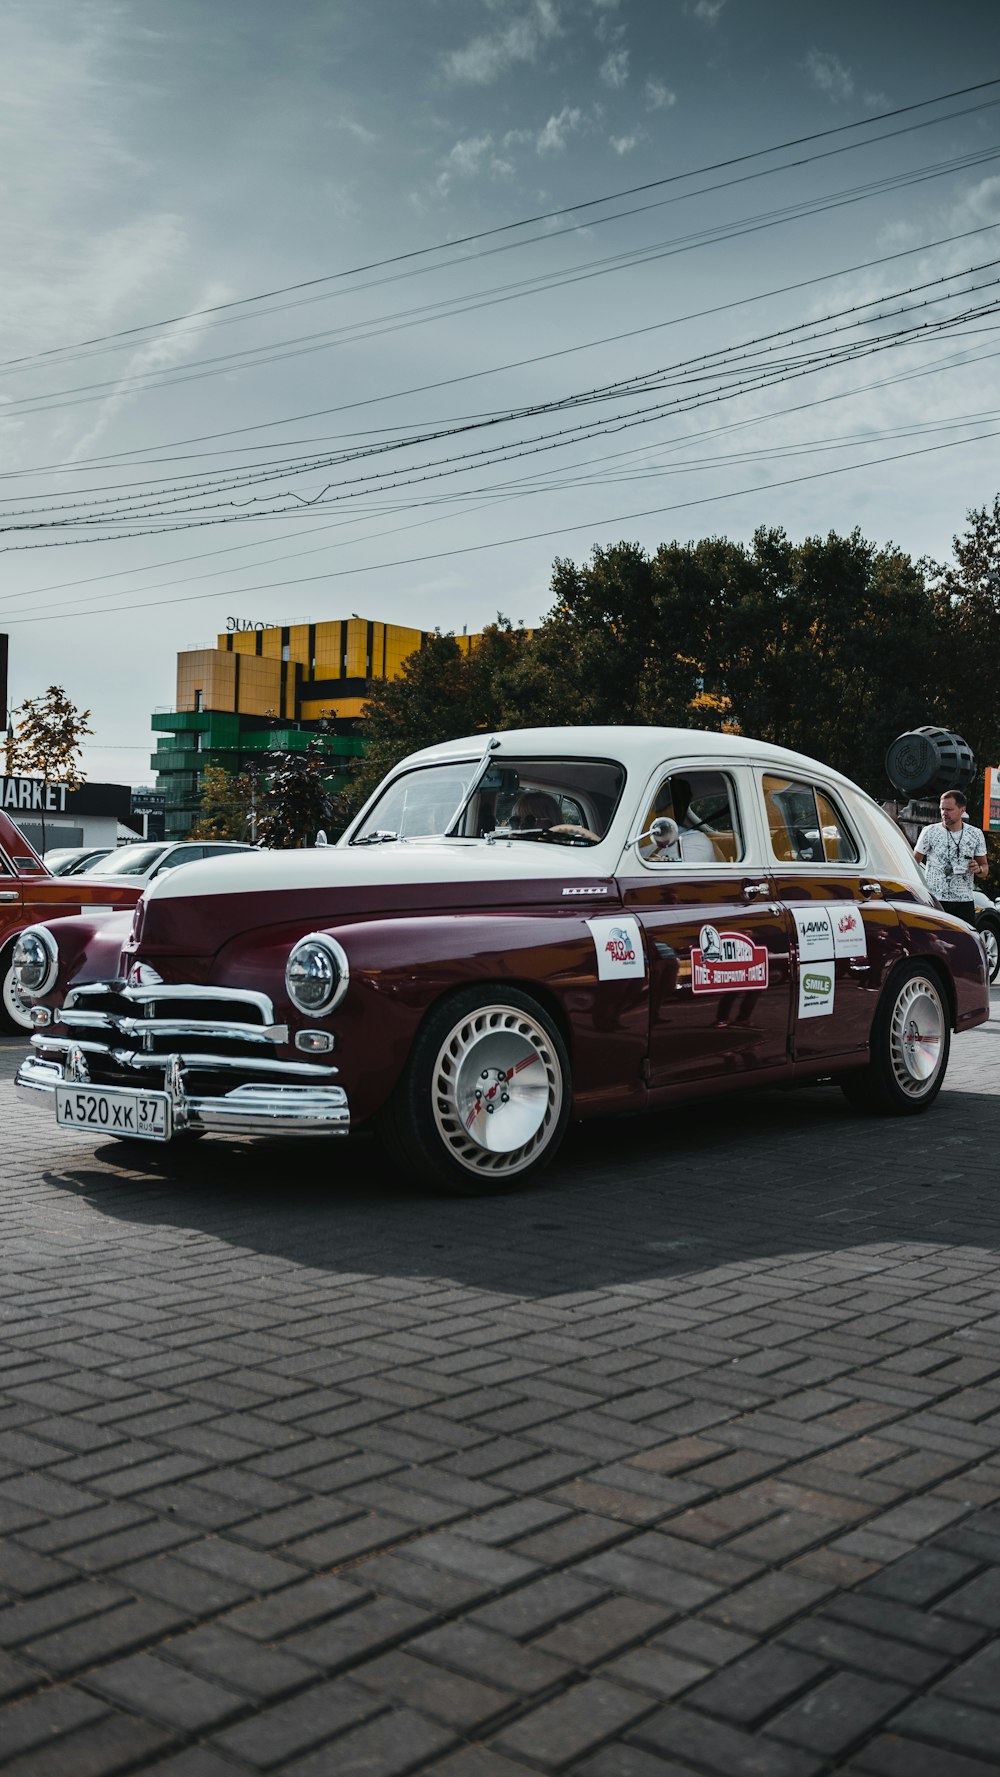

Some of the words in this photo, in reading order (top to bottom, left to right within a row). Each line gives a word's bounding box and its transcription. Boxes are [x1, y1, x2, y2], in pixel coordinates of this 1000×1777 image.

[605, 941, 624, 951] АВТО
[723, 941, 736, 960] 101
[611, 950, 635, 961] РАДИО
[695, 964, 711, 985] ПЛЁС
[713, 969, 746, 984] АВТОРАЛЛИ
[748, 962, 766, 982] ПАЛЕХ
[805, 979, 830, 992] SMILE
[139, 1100, 158, 1123] 37
[139, 1122, 153, 1132] RUS
